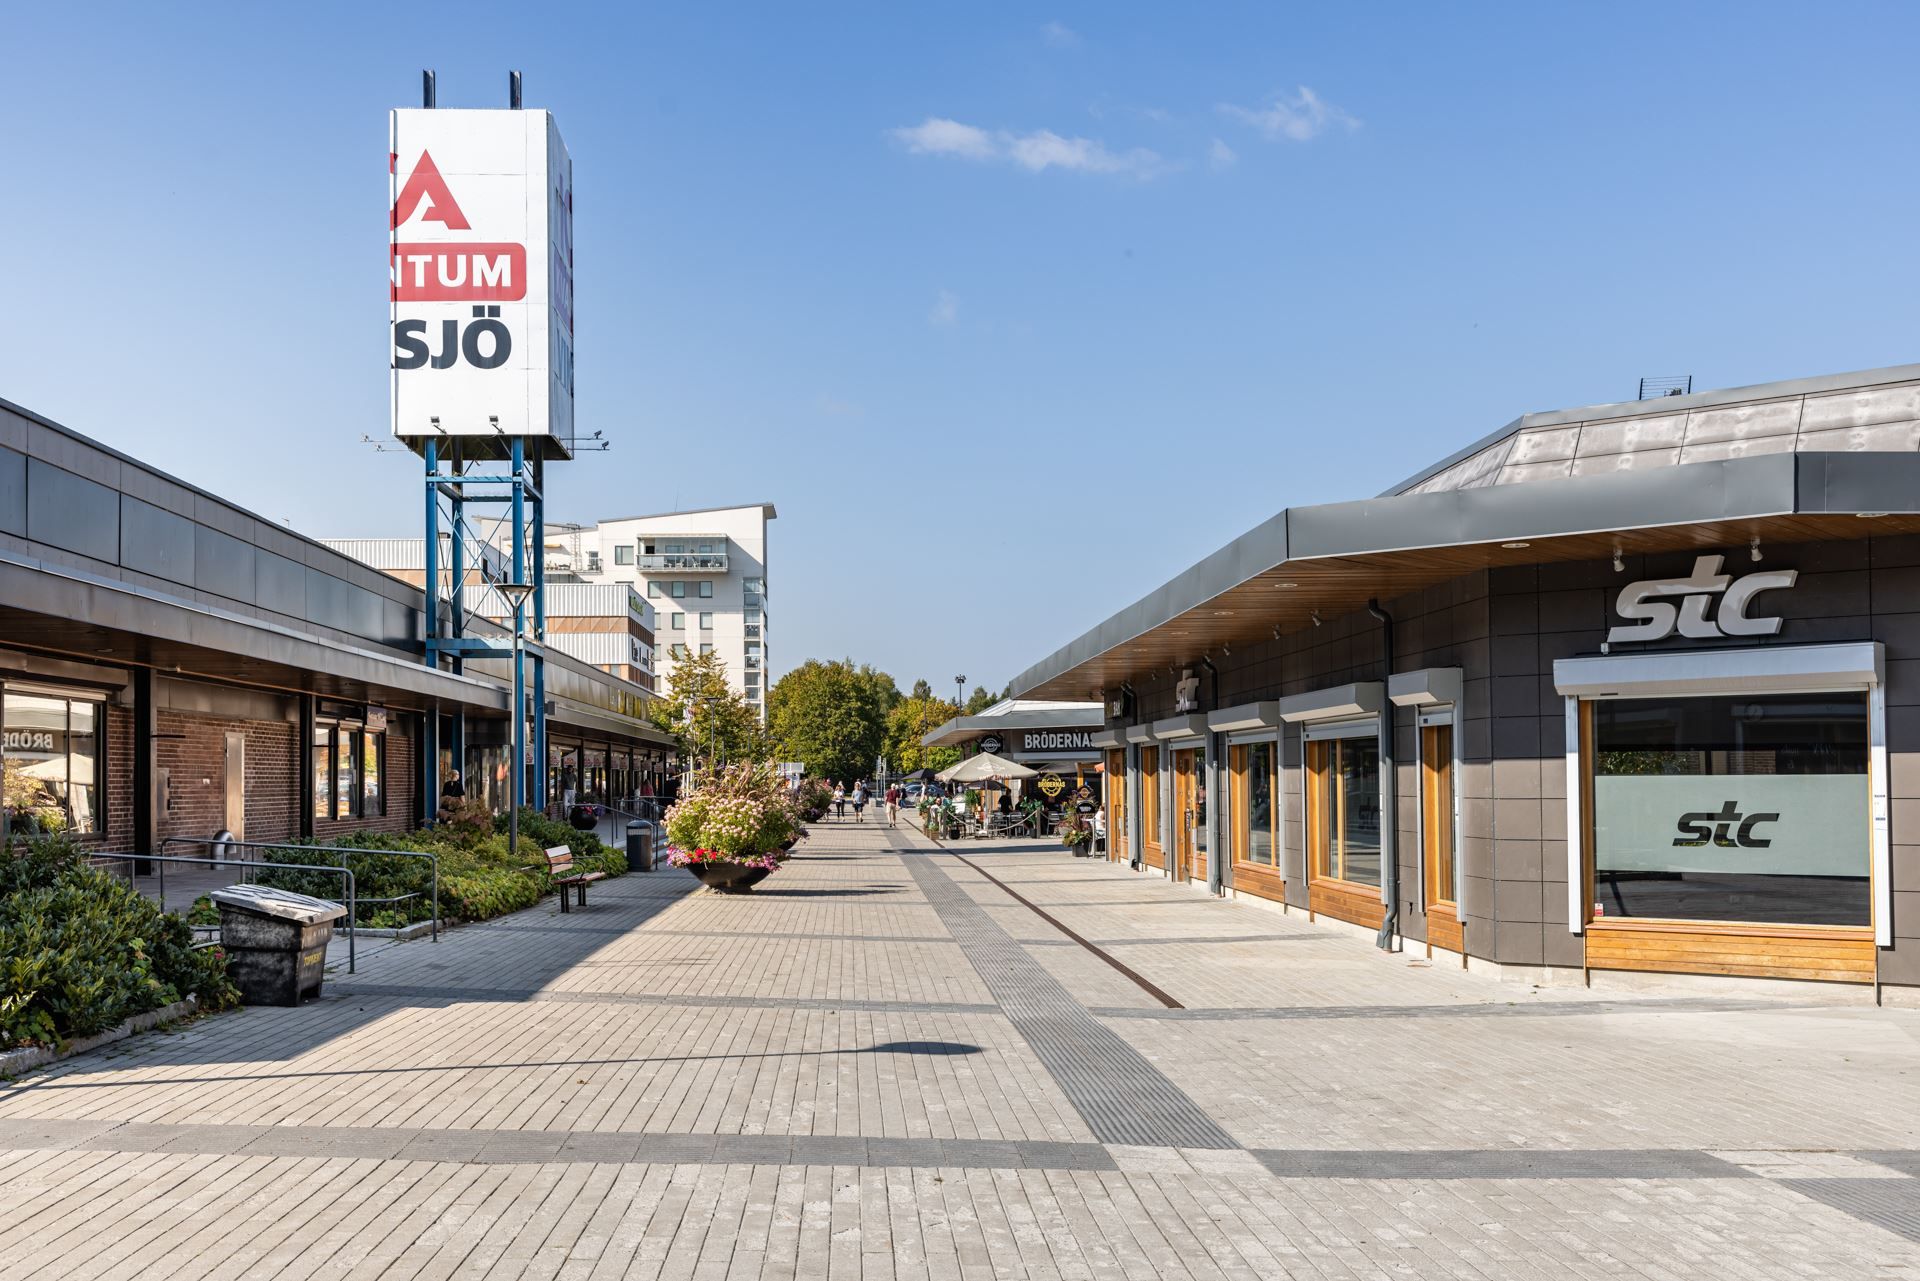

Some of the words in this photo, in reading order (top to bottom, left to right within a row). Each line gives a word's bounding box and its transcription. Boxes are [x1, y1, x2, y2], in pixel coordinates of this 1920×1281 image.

[390, 149, 472, 231] A
[391, 305, 512, 370] SJÖ
[1607, 554, 1798, 643] stc
[1672, 801, 1780, 848] stc
